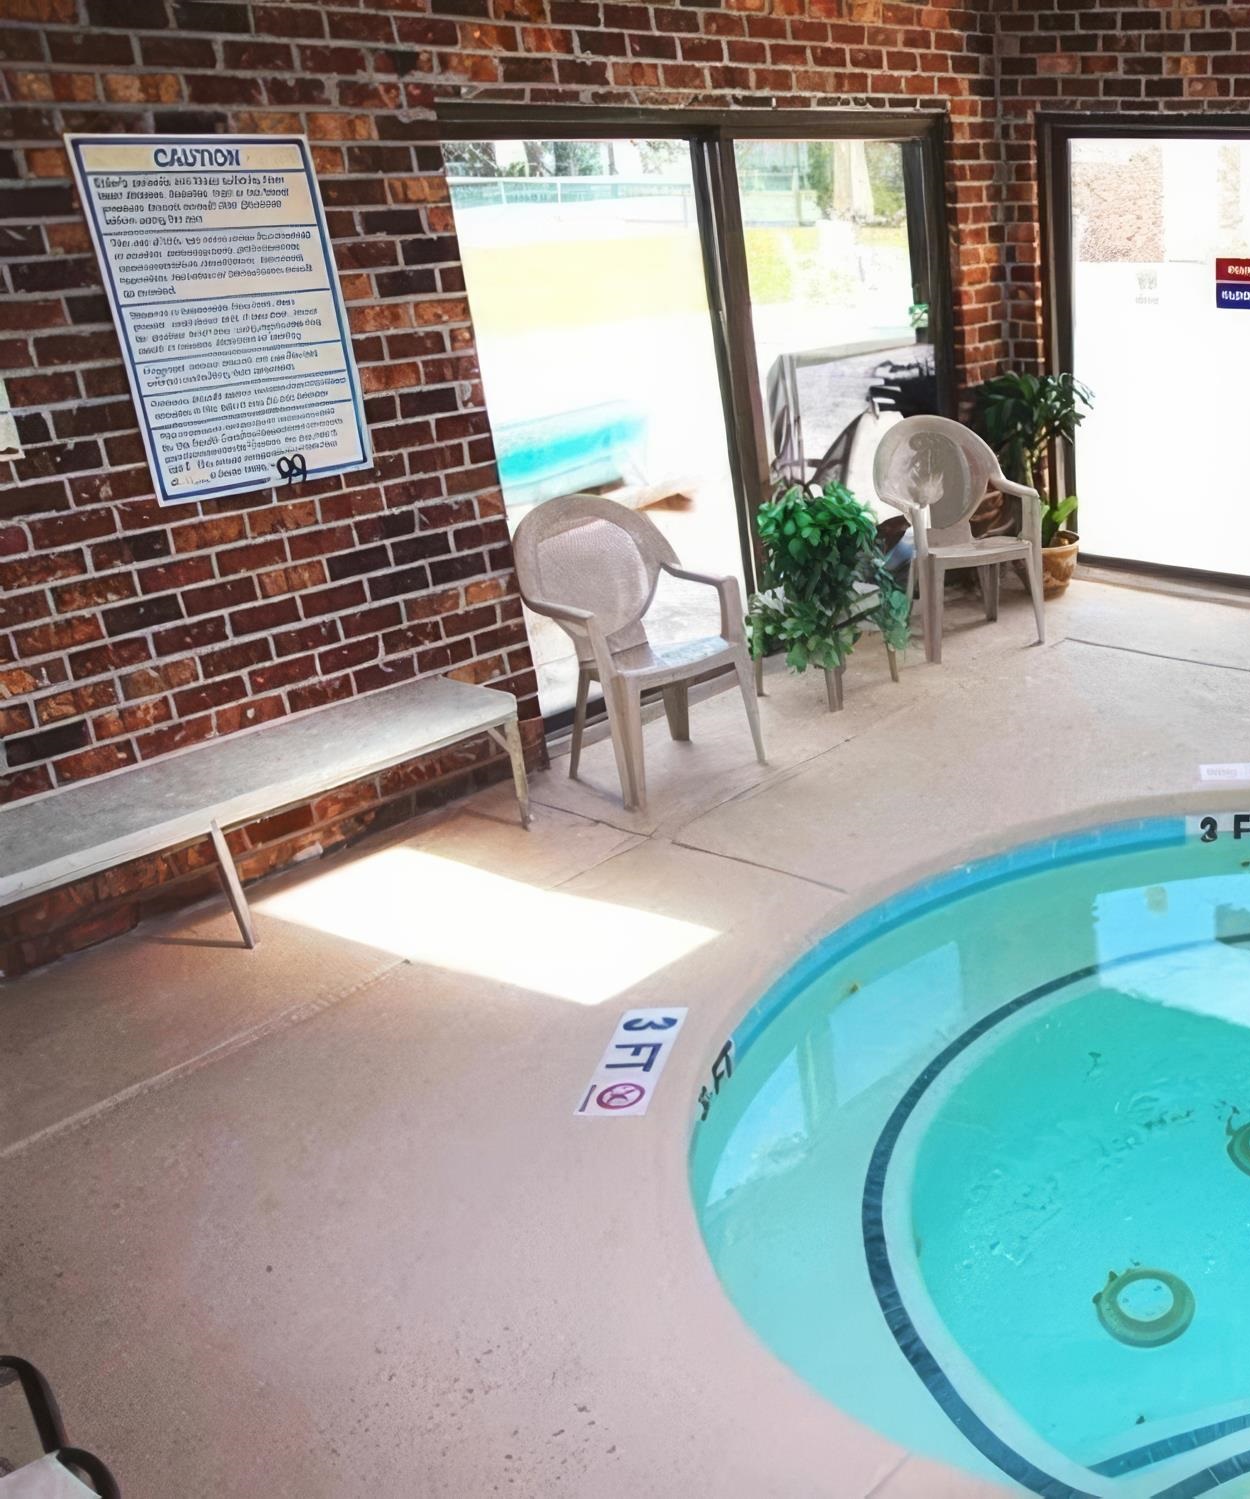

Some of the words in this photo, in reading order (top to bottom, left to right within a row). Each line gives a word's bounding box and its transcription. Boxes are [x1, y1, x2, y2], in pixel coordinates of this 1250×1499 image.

[153, 148, 241, 168] CAUTION
[1200, 816, 1218, 843] 3
[622, 1017, 678, 1031] 3
[605, 1043, 663, 1072] FT
[712, 1039, 733, 1095] FT
